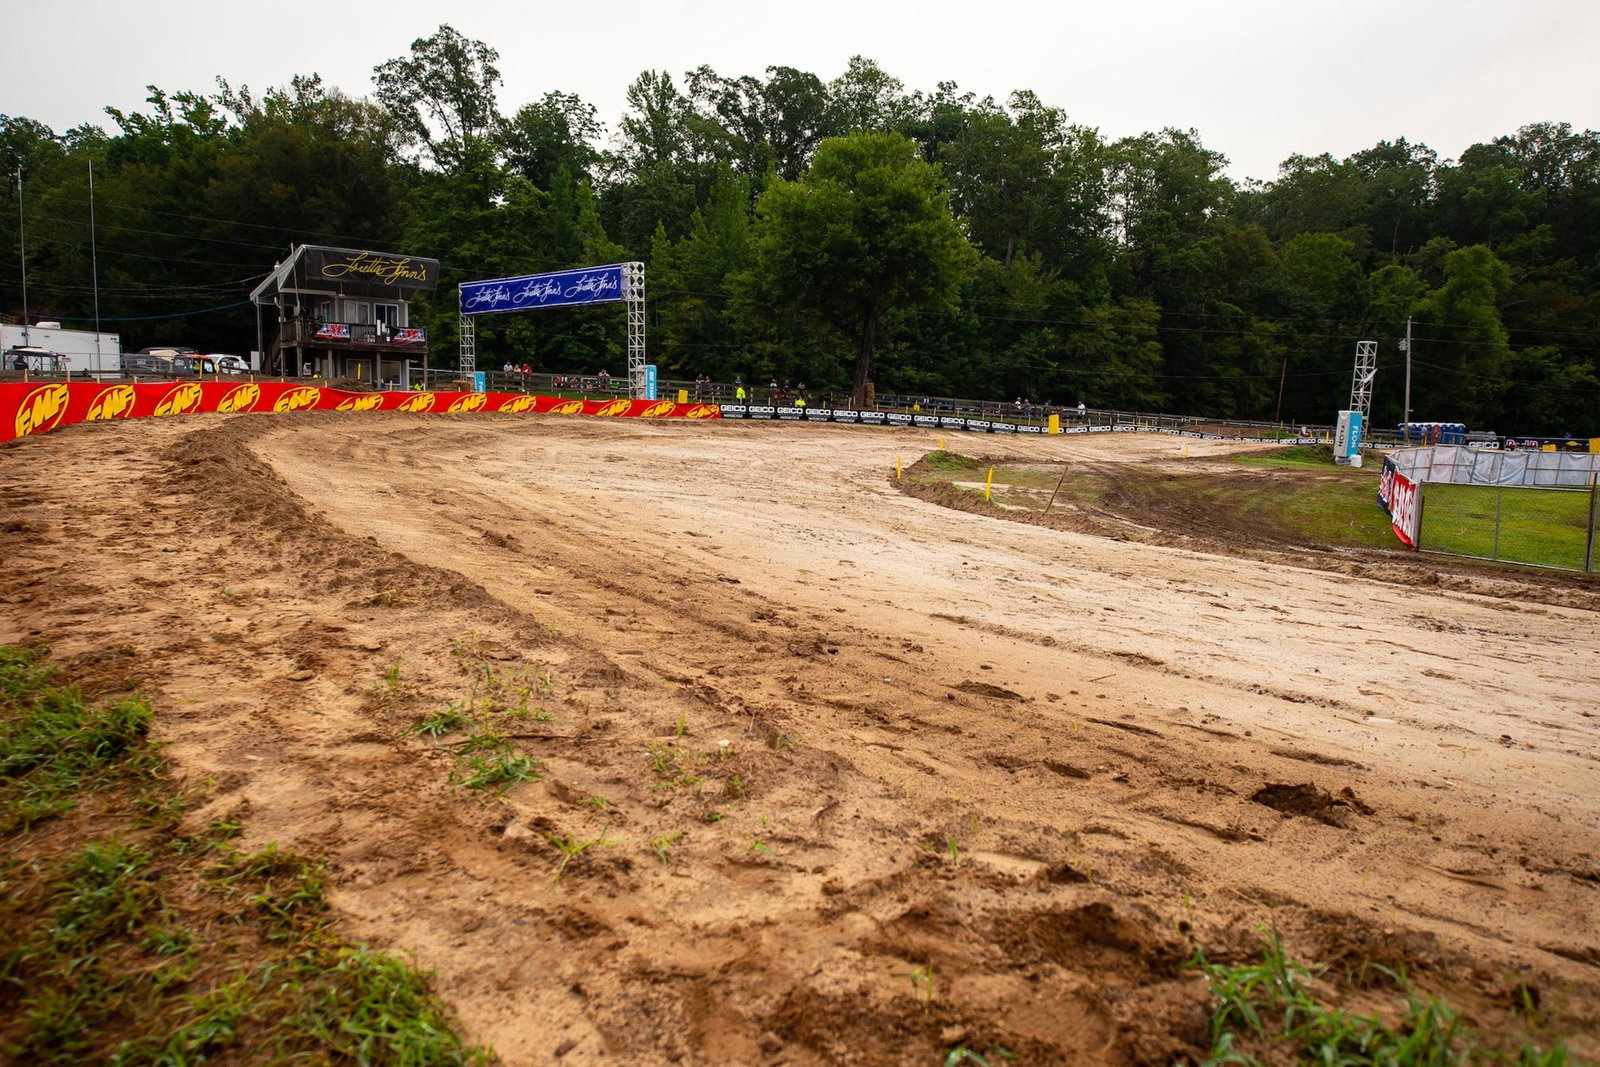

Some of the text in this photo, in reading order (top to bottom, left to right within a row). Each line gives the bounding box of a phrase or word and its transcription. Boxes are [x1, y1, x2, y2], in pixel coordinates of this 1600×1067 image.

[322, 252, 427, 286] Loretta Lynn's
[16, 383, 68, 437] FMF
[720, 404, 746, 412] GEICO
[749, 405, 775, 413] GEICO
[805, 408, 831, 416] GEICO
[833, 409, 858, 417] GEICO
[860, 411, 885, 419] GEICO
[887, 413, 912, 421] GEICO
[914, 415, 939, 423] GEICO
[966, 419, 990, 427] GEICO
[992, 422, 1015, 430] GEICO
[1468, 441, 1500, 449] GEICO
